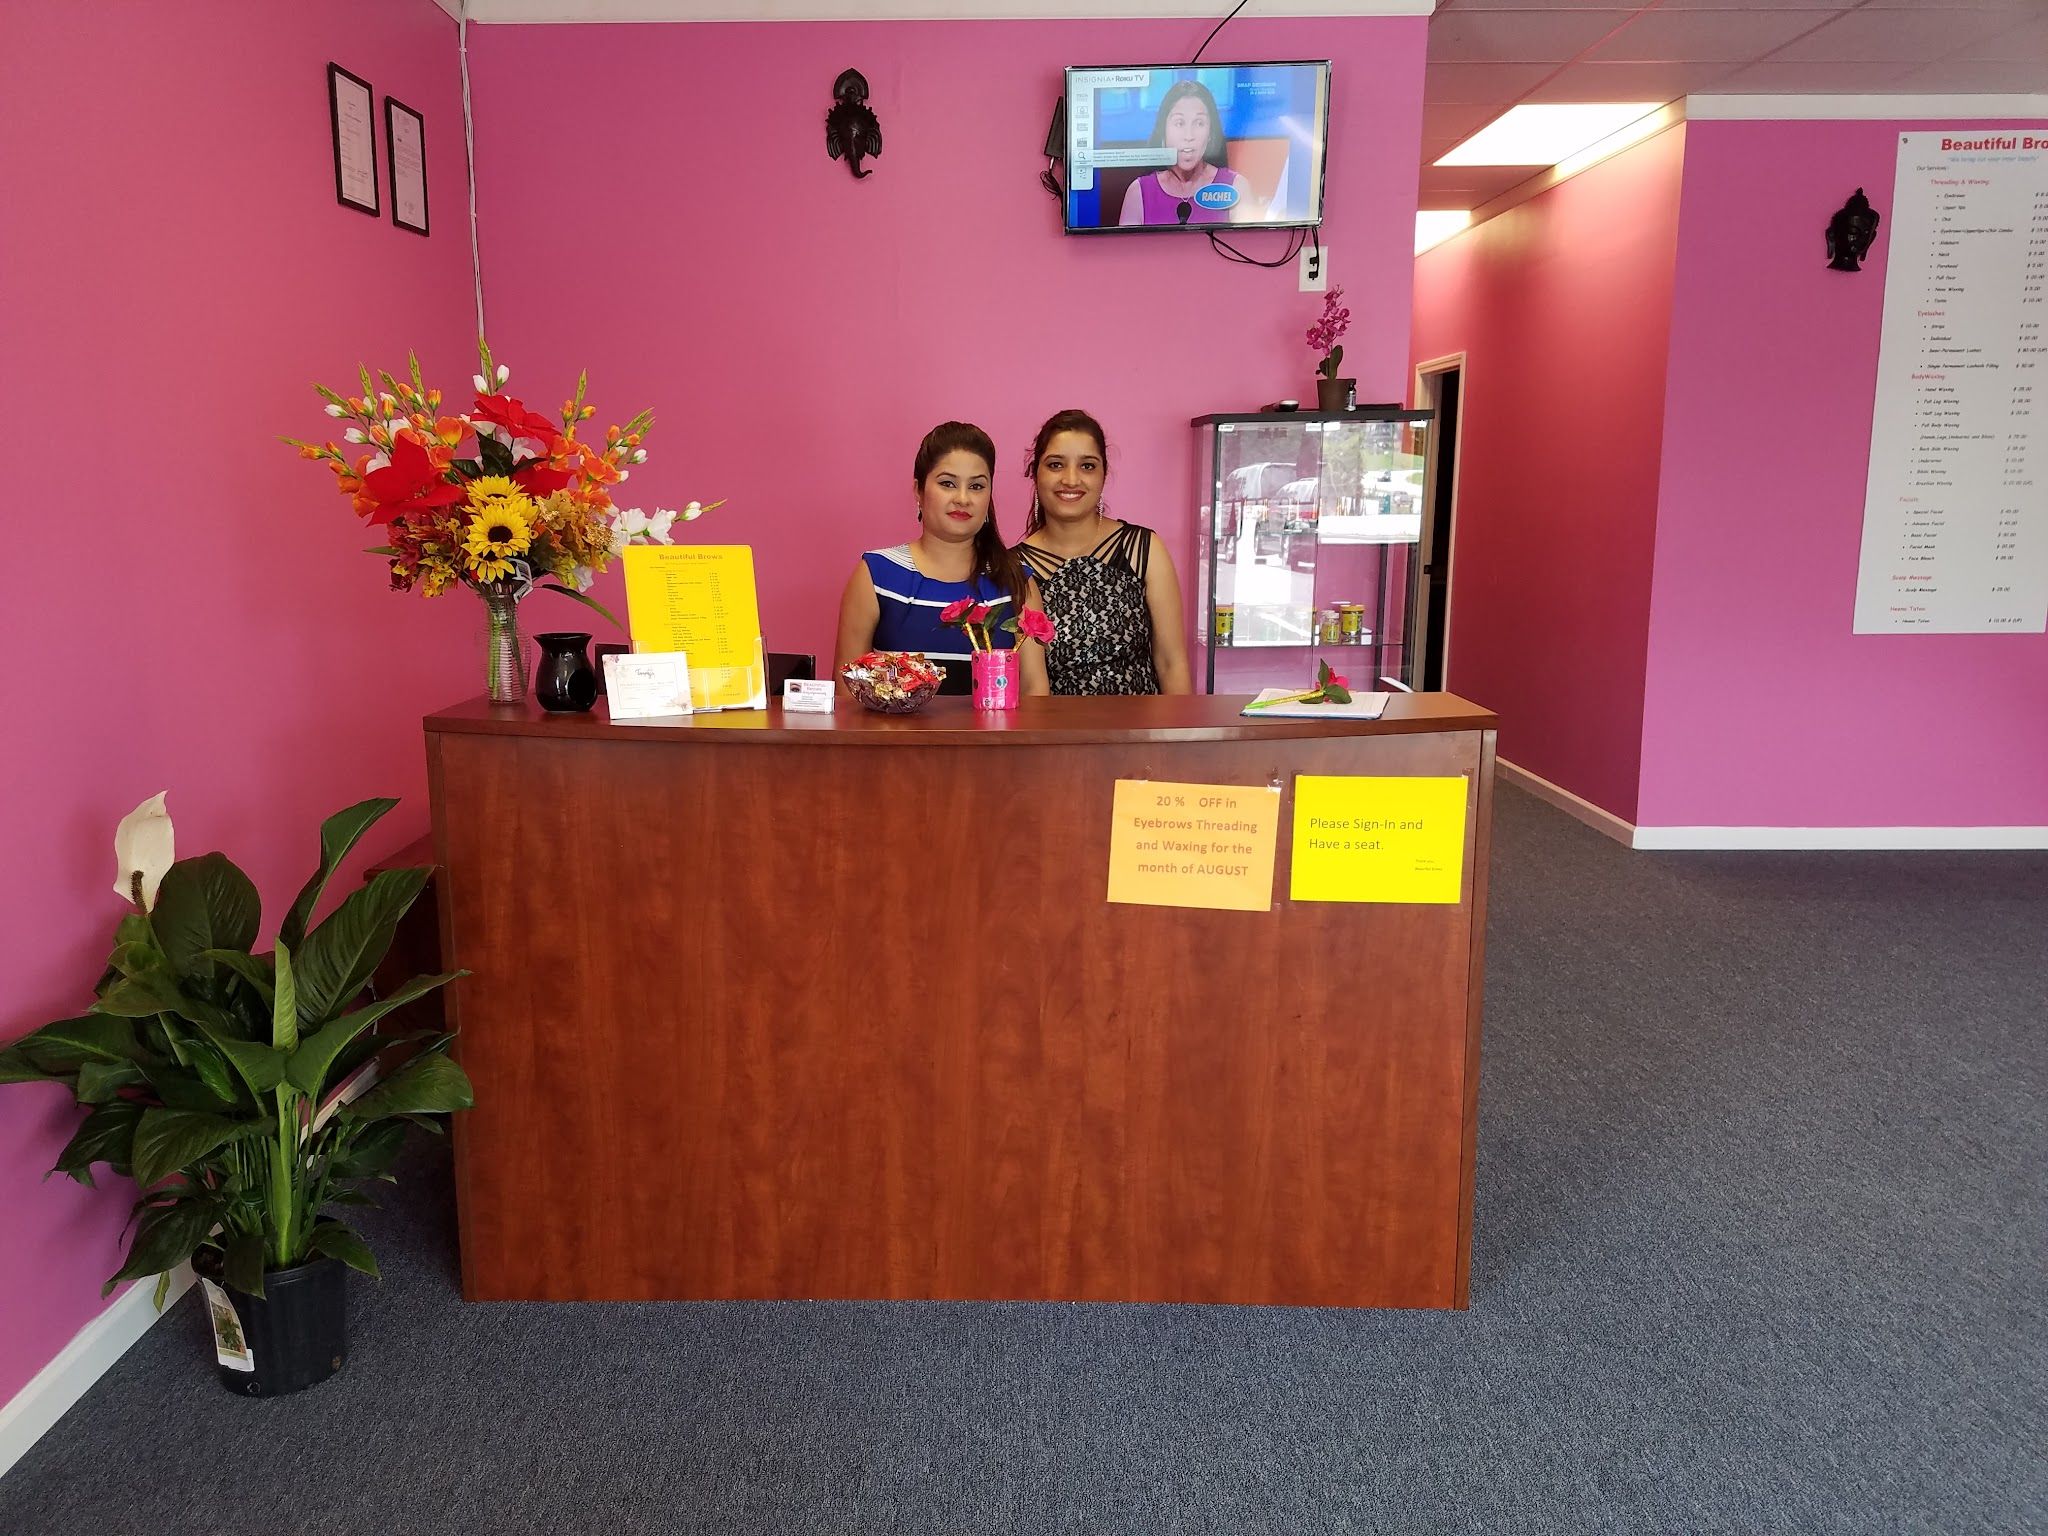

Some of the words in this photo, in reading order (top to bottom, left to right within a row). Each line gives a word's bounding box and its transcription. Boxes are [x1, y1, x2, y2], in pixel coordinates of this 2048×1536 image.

[1942, 138, 2016, 150] Beautiful
[1202, 191, 1232, 202] RACHEL
[1157, 796, 1171, 806] 20
[1175, 796, 1185, 807] %
[1199, 798, 1222, 808] OFF
[1226, 798, 1237, 808] in
[1134, 817, 1192, 830] Eyebrows
[1196, 819, 1257, 834] Threading
[1310, 818, 1350, 829] Please
[1353, 818, 1395, 831] Sign-In
[1400, 819, 1423, 830] and
[1136, 840, 1158, 850] and
[1163, 841, 1207, 854] Waxing
[1211, 842, 1229, 853] for
[1233, 844, 1252, 854] the
[1309, 838, 1340, 849] Have
[1343, 841, 1350, 849] a
[1355, 840, 1384, 850] seat.
[1138, 863, 1177, 873] month
[1182, 864, 1194, 874] of
[1197, 864, 1248, 876] AUGUST
